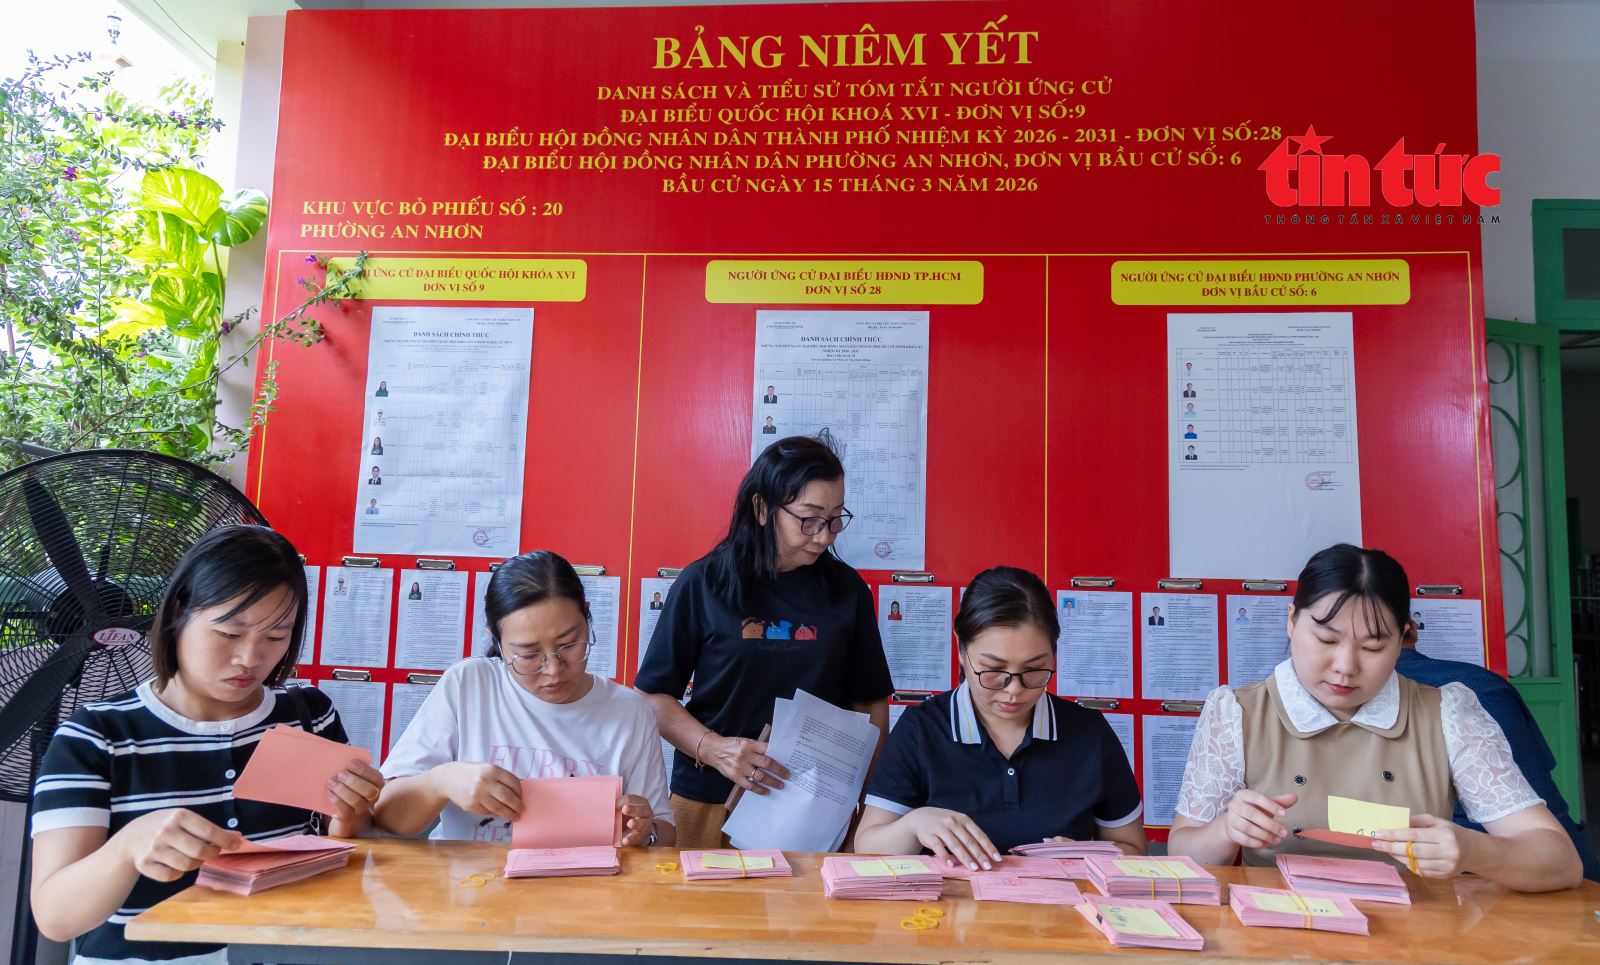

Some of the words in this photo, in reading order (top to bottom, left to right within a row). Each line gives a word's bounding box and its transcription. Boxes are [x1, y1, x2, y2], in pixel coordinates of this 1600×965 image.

[653, 24, 785, 70] BẢNG
[798, 23, 927, 68] NIÊM
[941, 15, 1039, 65] YẾT
[598, 86, 654, 100] DANH
[662, 82, 716, 100] SÁCH
[725, 81, 751, 98] VÀ
[758, 78, 807, 98] TIỂU
[814, 79, 840, 98] SỬ
[846, 80, 895, 97] TÓM
[901, 76, 944, 97] TẮT
[950, 78, 1020, 96] NGƯỜI
[1028, 78, 1074, 95] ỨNG
[1082, 76, 1112, 95] CỬ
[621, 109, 656, 126] ĐẠI
[663, 102, 711, 122] BIỂU
[718, 102, 779, 124] QUỐC
[785, 104, 824, 124] HỘI
[831, 102, 893, 121] KHOÁ
[900, 106, 938, 120] XVI
[956, 105, 1002, 120] ĐƠN
[1010, 106, 1032, 122] VỊ
[1039, 98, 1085, 119] SỐ:9
[444, 132, 479, 149] ĐẠI
[486, 126, 533, 146] BIỂU
[539, 129, 576, 149] HỘI
[582, 126, 642, 146] ĐỒNG
[648, 129, 706, 146] NHÂN
[714, 128, 757, 145] DÂN
[764, 128, 838, 145] THÀNH
[845, 124, 890, 144] PHỐ
[896, 126, 968, 147] NHIỆM
[976, 126, 1007, 144] KỲ
[1014, 129, 1056, 143] 2026
[1075, 128, 1117, 142] 2031
[1137, 126, 1185, 142] ĐƠN
[1193, 127, 1216, 144] VỊ
[1222, 120, 1282, 141] SỐ:28
[483, 155, 519, 172] ĐẠI
[524, 149, 572, 169] BIỂU
[579, 152, 616, 172] HỘI
[623, 149, 682, 168] ĐỒNG
[689, 152, 749, 168] NHÂN
[755, 152, 799, 168] DÂN
[805, 150, 896, 168] PHƯỜNG
[904, 154, 933, 168] AN
[939, 152, 1008, 169] NHƠN,
[1014, 151, 1062, 167] ĐƠN
[1069, 153, 1091, 170] VỊ
[1100, 146, 1143, 166] BẦU
[1150, 147, 1182, 166] CỬ
[1188, 144, 1224, 166] SỐ:
[1230, 152, 1242, 165] 6
[662, 172, 704, 192] BẦU
[711, 175, 740, 192] CỬ
[746, 175, 806, 192] NGÀY
[814, 178, 833, 192] 15
[839, 174, 915, 192] THÁNG
[921, 178, 932, 192] 3
[938, 174, 988, 192] NĂM
[995, 177, 1038, 192] 2026
[302, 200, 346, 216] KHU
[352, 200, 394, 217] VỰC
[400, 197, 426, 216] BỎ
[432, 196, 494, 216] PHIẾU
[499, 195, 527, 216] SỐ
[542, 202, 563, 216] 20
[300, 222, 385, 238] PHƯỜNG
[390, 225, 419, 238] AN
[424, 225, 484, 239] NHƠN
[374, 267, 395, 278] ỨNG
[399, 267, 414, 278] CỬ
[416, 268, 436, 280] ĐẠI
[438, 266, 462, 278] BIỂU
[465, 266, 496, 281] QUỐC
[499, 267, 519, 281] HỘI
[522, 267, 553, 279] KHÓA
[556, 271, 576, 280] XVI
[728, 269, 767, 280] NGƯỜI
[771, 269, 796, 280] ỨNG
[800, 269, 817, 280] CỬ
[819, 271, 841, 282] ĐẠI
[844, 268, 872, 280] BIỂU
[876, 272, 910, 280] HĐND
[914, 272, 961, 280] TP.HCM
[1120, 272, 1157, 282] NGƯỜI
[1161, 272, 1184, 282] ỨNG
[1188, 270, 1203, 282] CỬ
[1206, 273, 1226, 283] ĐẠI
[1229, 270, 1256, 282] BIỂU
[1259, 273, 1292, 282] HĐND
[1295, 271, 1344, 282] PHƯỜNG
[1346, 273, 1363, 281] AN
[1366, 271, 1400, 281] NHƠN
[424, 283, 446, 292] ĐƠN
[449, 283, 461, 293] VỊ
[463, 281, 477, 292] SỐ
[479, 283, 485, 292] 9
[805, 285, 831, 295] ĐƠN
[836, 285, 847, 296] VỊ
[850, 282, 867, 295] SỐ
[869, 286, 881, 294] 28
[1202, 288, 1226, 297] ĐƠN
[1230, 288, 1241, 299] VỊ
[1244, 284, 1267, 297] BẦU
[1270, 285, 1287, 297] CỬ
[1290, 284, 1308, 297] SỐ:
[1311, 288, 1317, 297] 6
[99, 632, 136, 641] LIFAN
